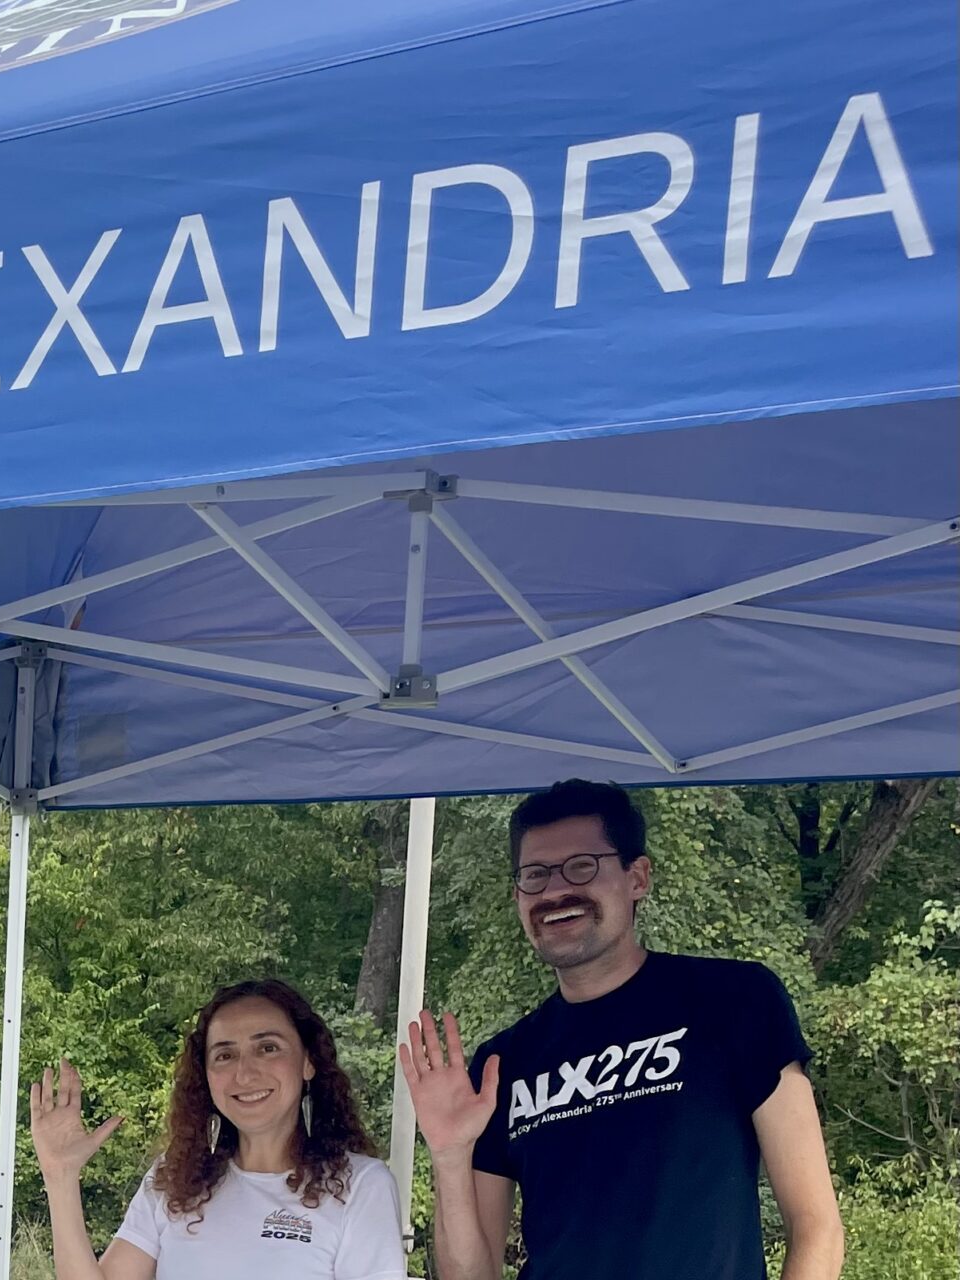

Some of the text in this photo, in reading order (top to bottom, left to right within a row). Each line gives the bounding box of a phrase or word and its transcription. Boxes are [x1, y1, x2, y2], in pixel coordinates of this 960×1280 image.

[508, 1027, 688, 1129] ALX275
[623, 1081, 683, 1100] Anniversary
[261, 1230, 311, 1243] 2025
